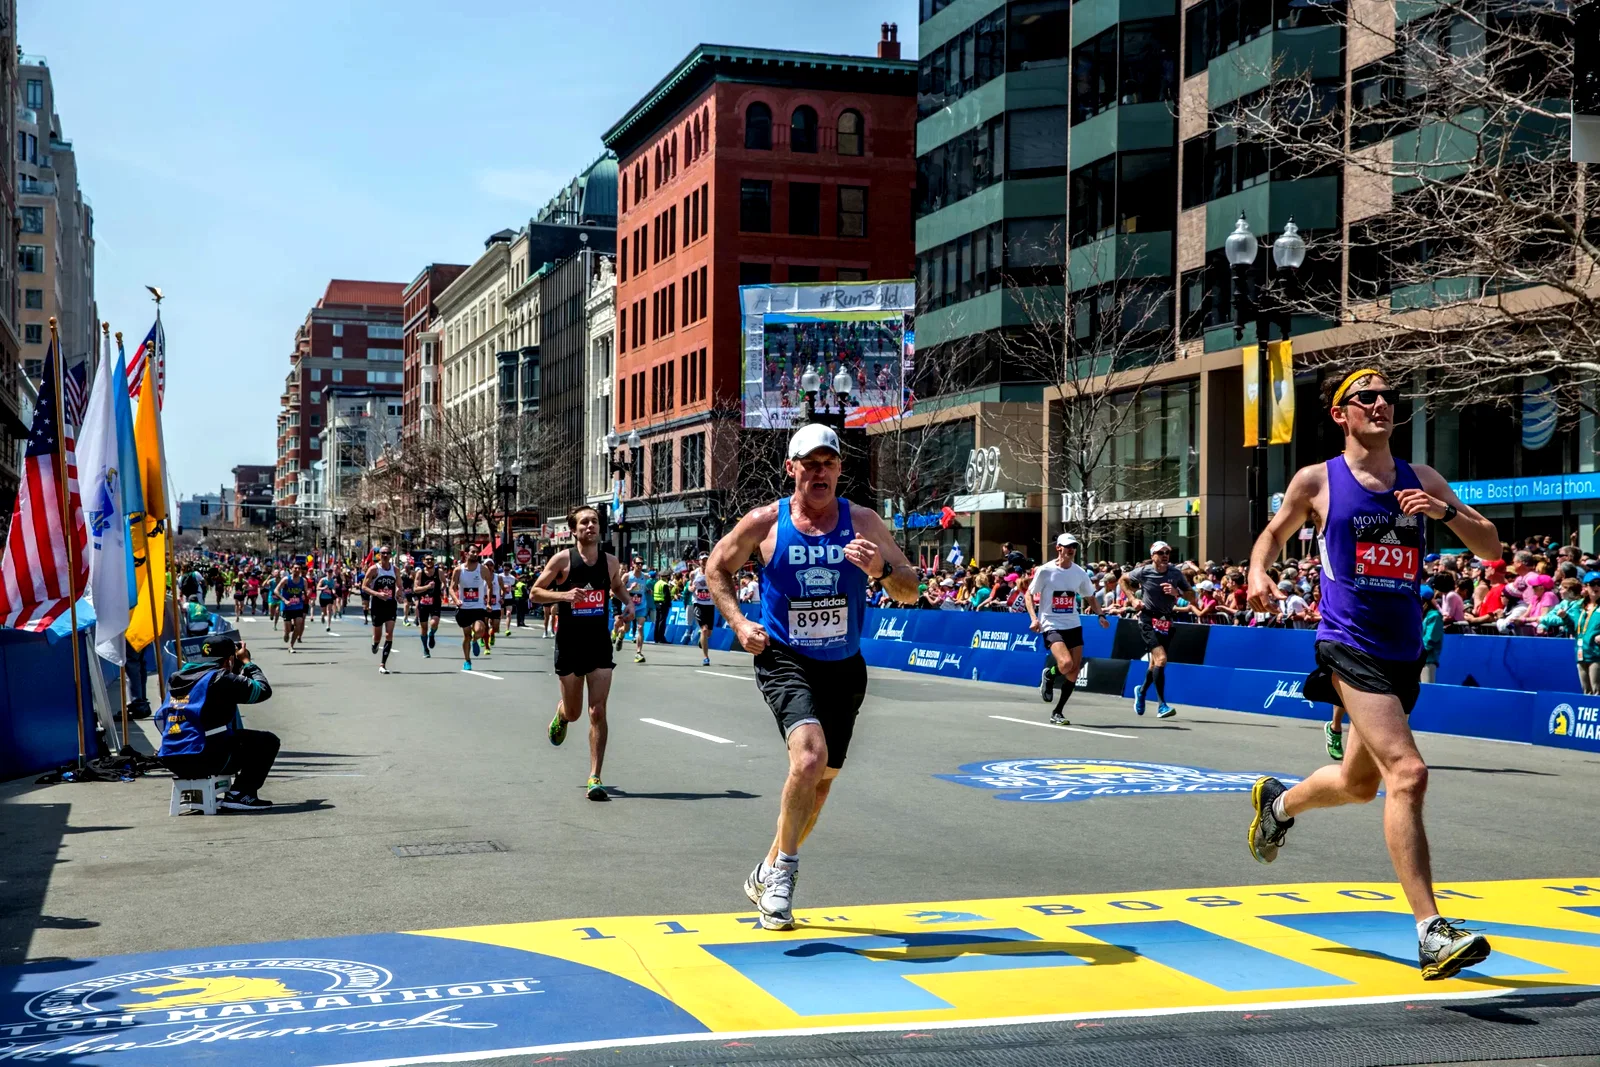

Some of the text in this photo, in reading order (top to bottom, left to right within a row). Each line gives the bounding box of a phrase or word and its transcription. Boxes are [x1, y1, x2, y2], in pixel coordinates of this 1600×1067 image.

[819, 286, 899, 308] #RunBold
[965, 446, 1000, 493] 699
[1464, 484, 1483, 499] the
[1487, 483, 1529, 498] Boston
[1532, 479, 1596, 495] Marathon.
[788, 545, 845, 565] BPD
[1363, 546, 1413, 570] 4291
[1357, 564, 1364, 573] 5
[813, 598, 846, 608] adidas
[1054, 597, 1073, 605] 3834
[797, 610, 841, 628] 8995
[982, 631, 1009, 641] THE BOSTON
[918, 649, 940, 659] THE BOSTON
[981, 641, 1008, 650] MARATHON
[916, 658, 939, 668] MARATHON
[1577, 706, 1599, 722] THE
[1020, 786, 1143, 801] John
[89, 960, 249, 989] ATHLETIC
[166, 980, 532, 1022] MARATHON
[144, 1004, 499, 1047] Hancock
